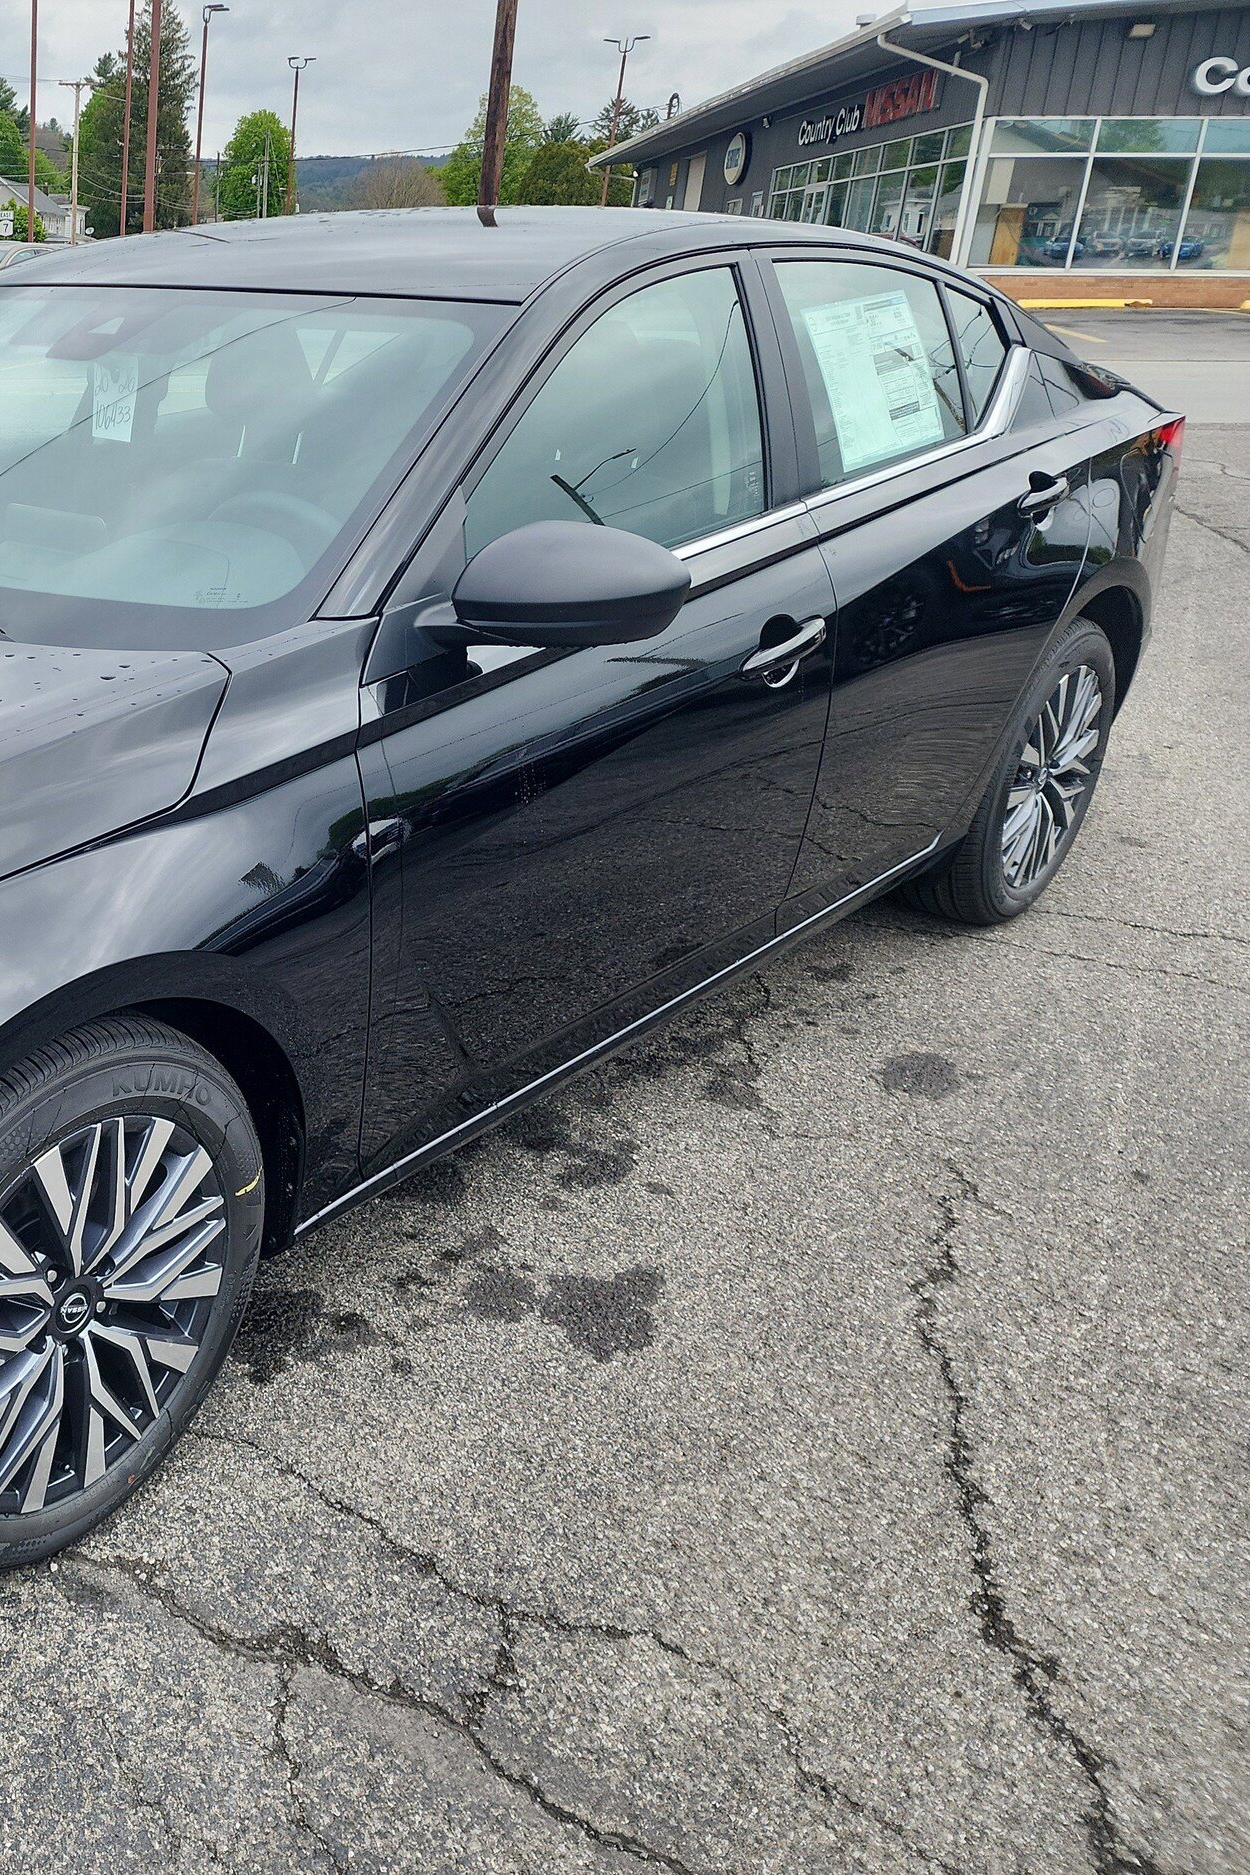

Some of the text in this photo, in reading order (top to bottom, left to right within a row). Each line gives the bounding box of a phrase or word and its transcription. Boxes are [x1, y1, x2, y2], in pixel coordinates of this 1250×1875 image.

[798, 69, 940, 145] Country Club NISSAN
[3, 223, 9, 233] 7
